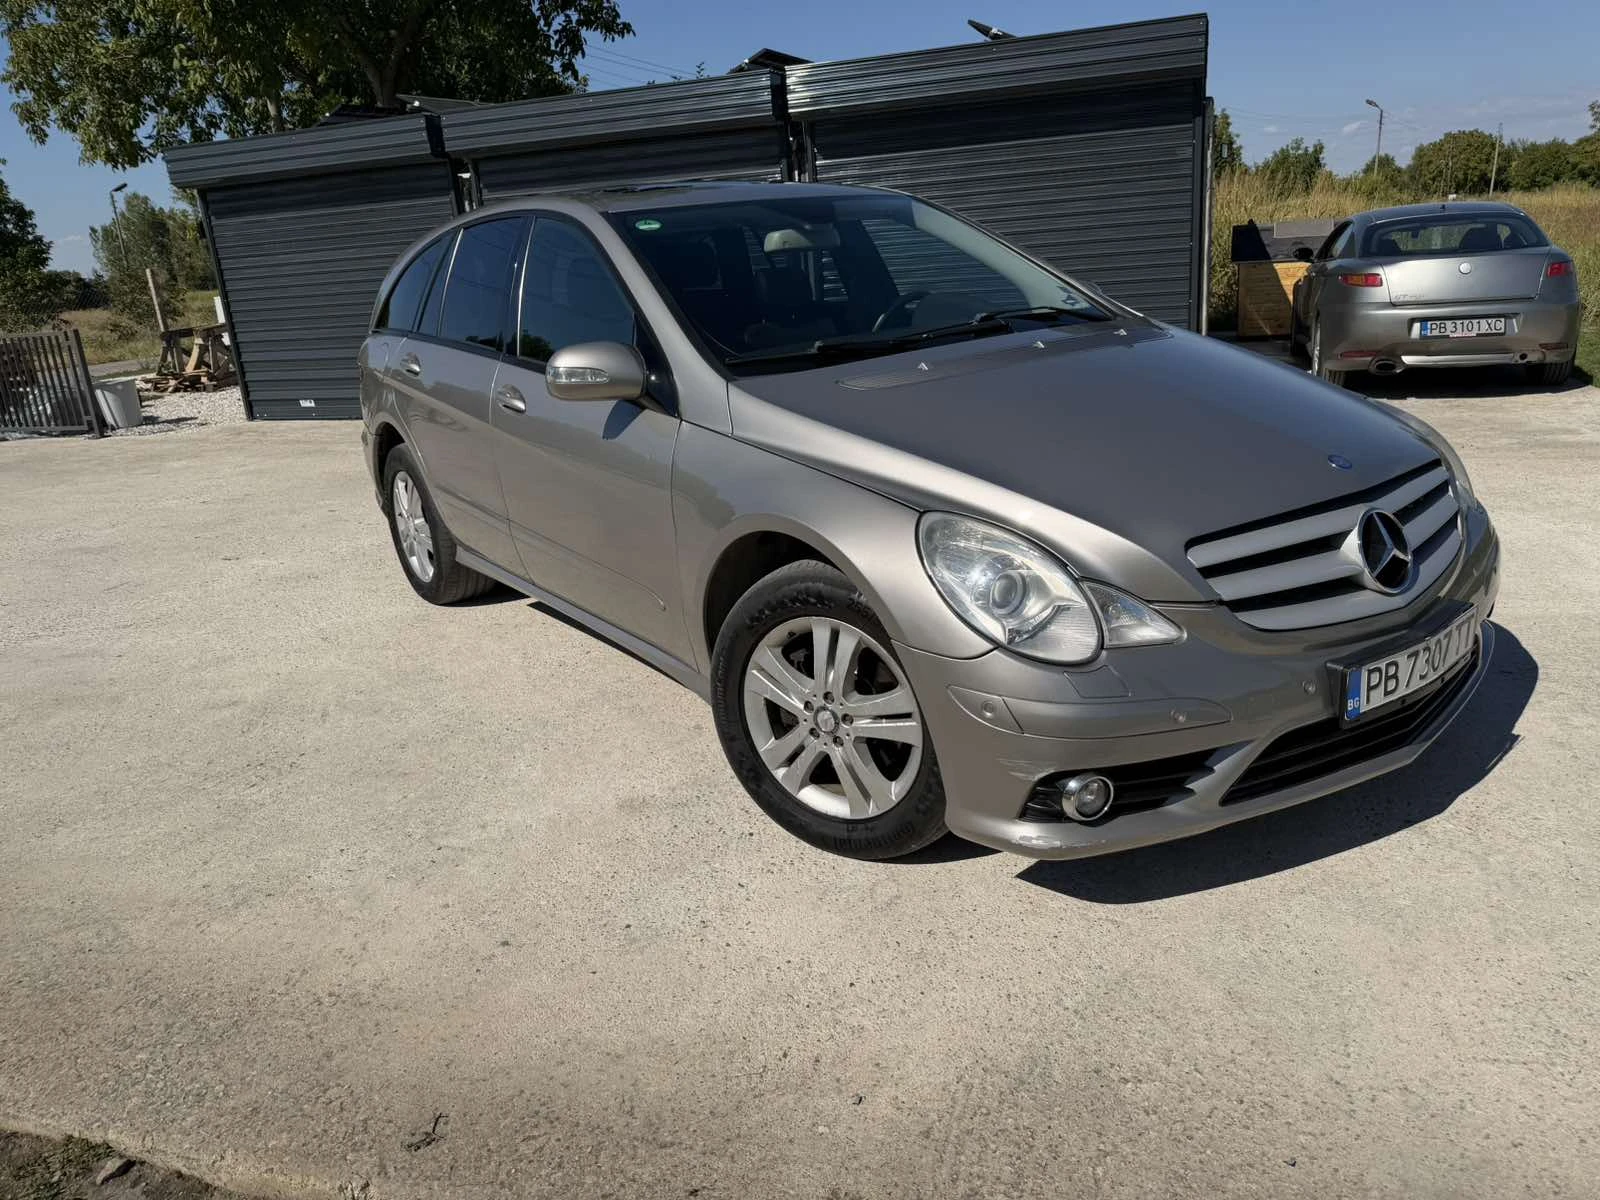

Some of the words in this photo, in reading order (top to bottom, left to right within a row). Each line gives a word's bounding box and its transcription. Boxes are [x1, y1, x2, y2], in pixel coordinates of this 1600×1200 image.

[1430, 322, 1447, 335] PB
[1450, 321, 1481, 334] 3101
[1485, 319, 1503, 332] XC
[1365, 661, 1399, 706] PB
[1347, 697, 1360, 711] BG
